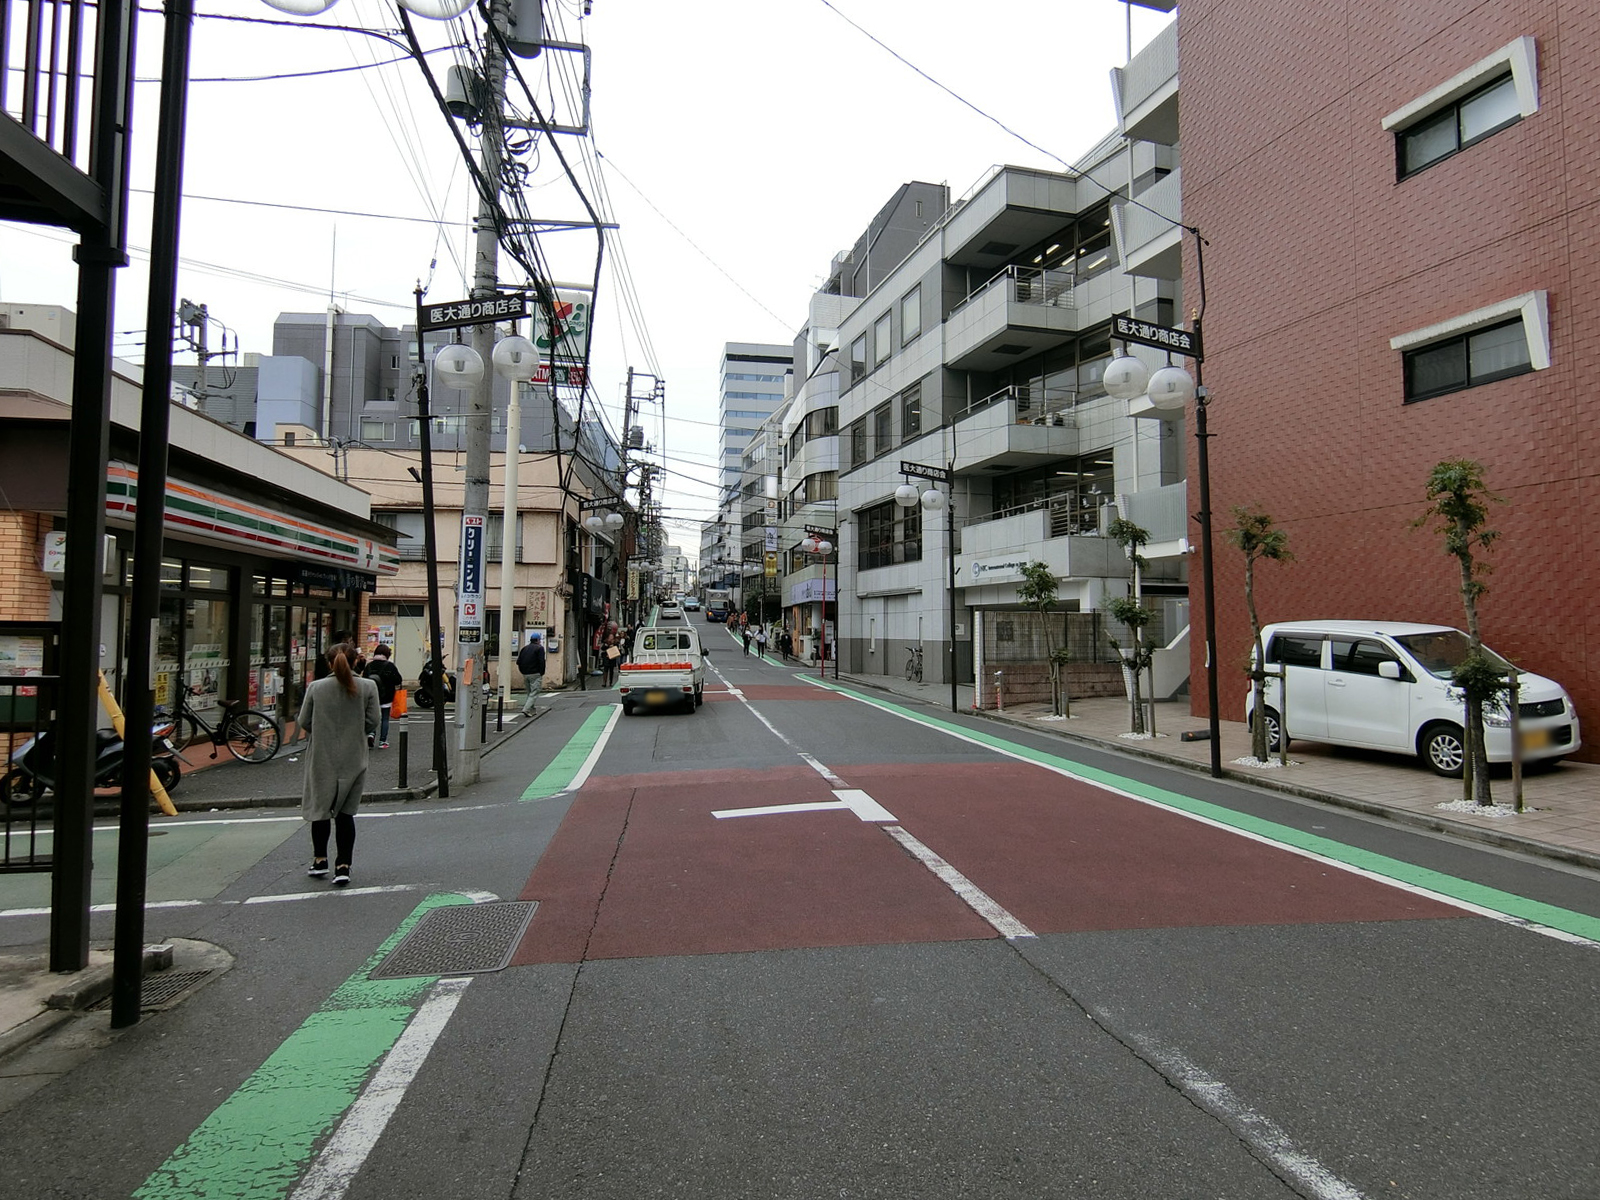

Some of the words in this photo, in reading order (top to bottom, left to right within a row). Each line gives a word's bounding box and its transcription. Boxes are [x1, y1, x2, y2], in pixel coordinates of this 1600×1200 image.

[430, 297, 522, 324] 医大通り商店会
[1117, 318, 1191, 349] 医大通り商店会
[902, 463, 947, 479] 医大通り商店会
